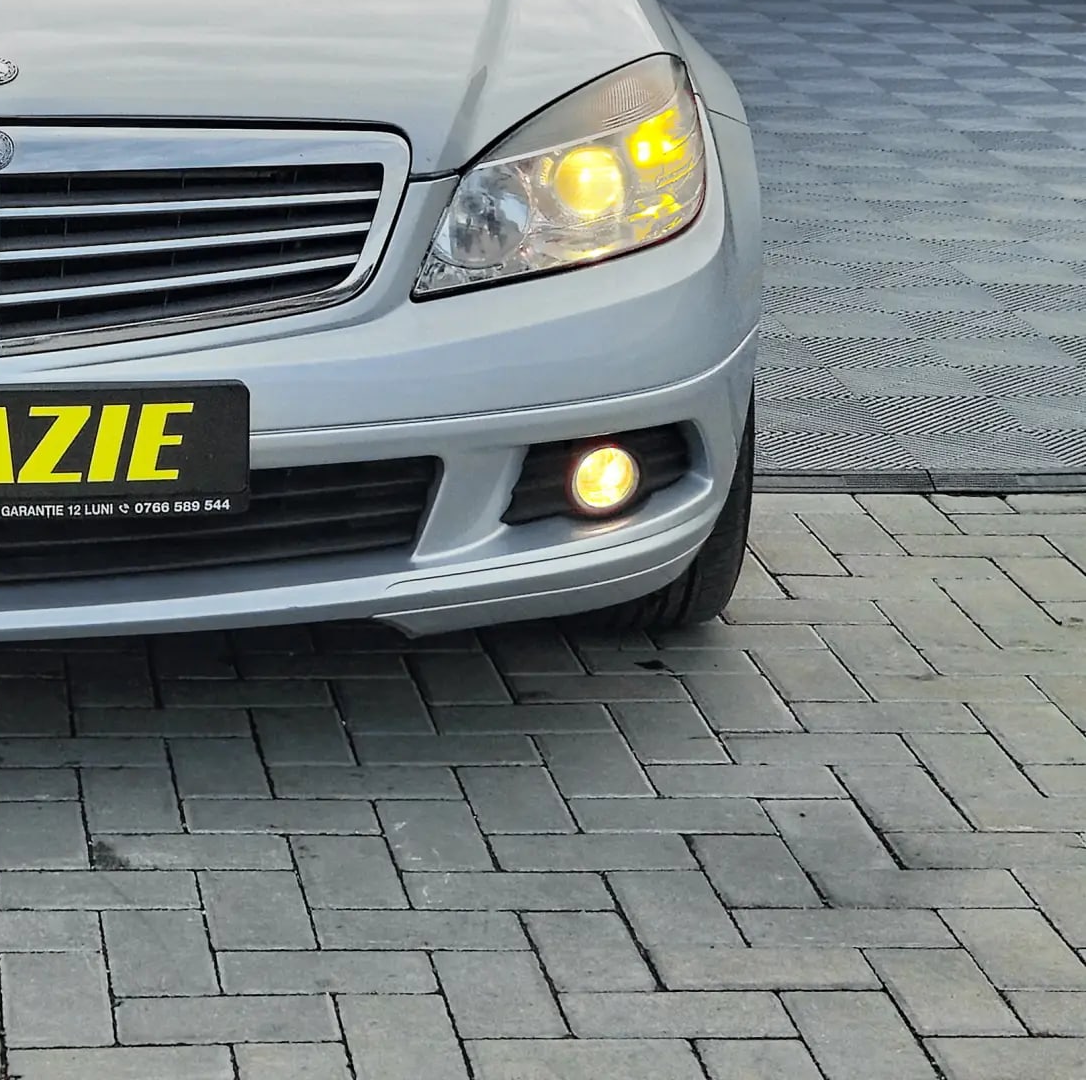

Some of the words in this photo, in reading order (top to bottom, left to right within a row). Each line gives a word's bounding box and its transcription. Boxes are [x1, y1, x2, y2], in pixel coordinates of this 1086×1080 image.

[1, 504, 64, 518] GARANȚIE
[67, 505, 81, 516] 12
[84, 504, 113, 515] LUNI
[134, 502, 170, 513] 0766
[174, 501, 200, 512] 589
[204, 499, 231, 510] 544
